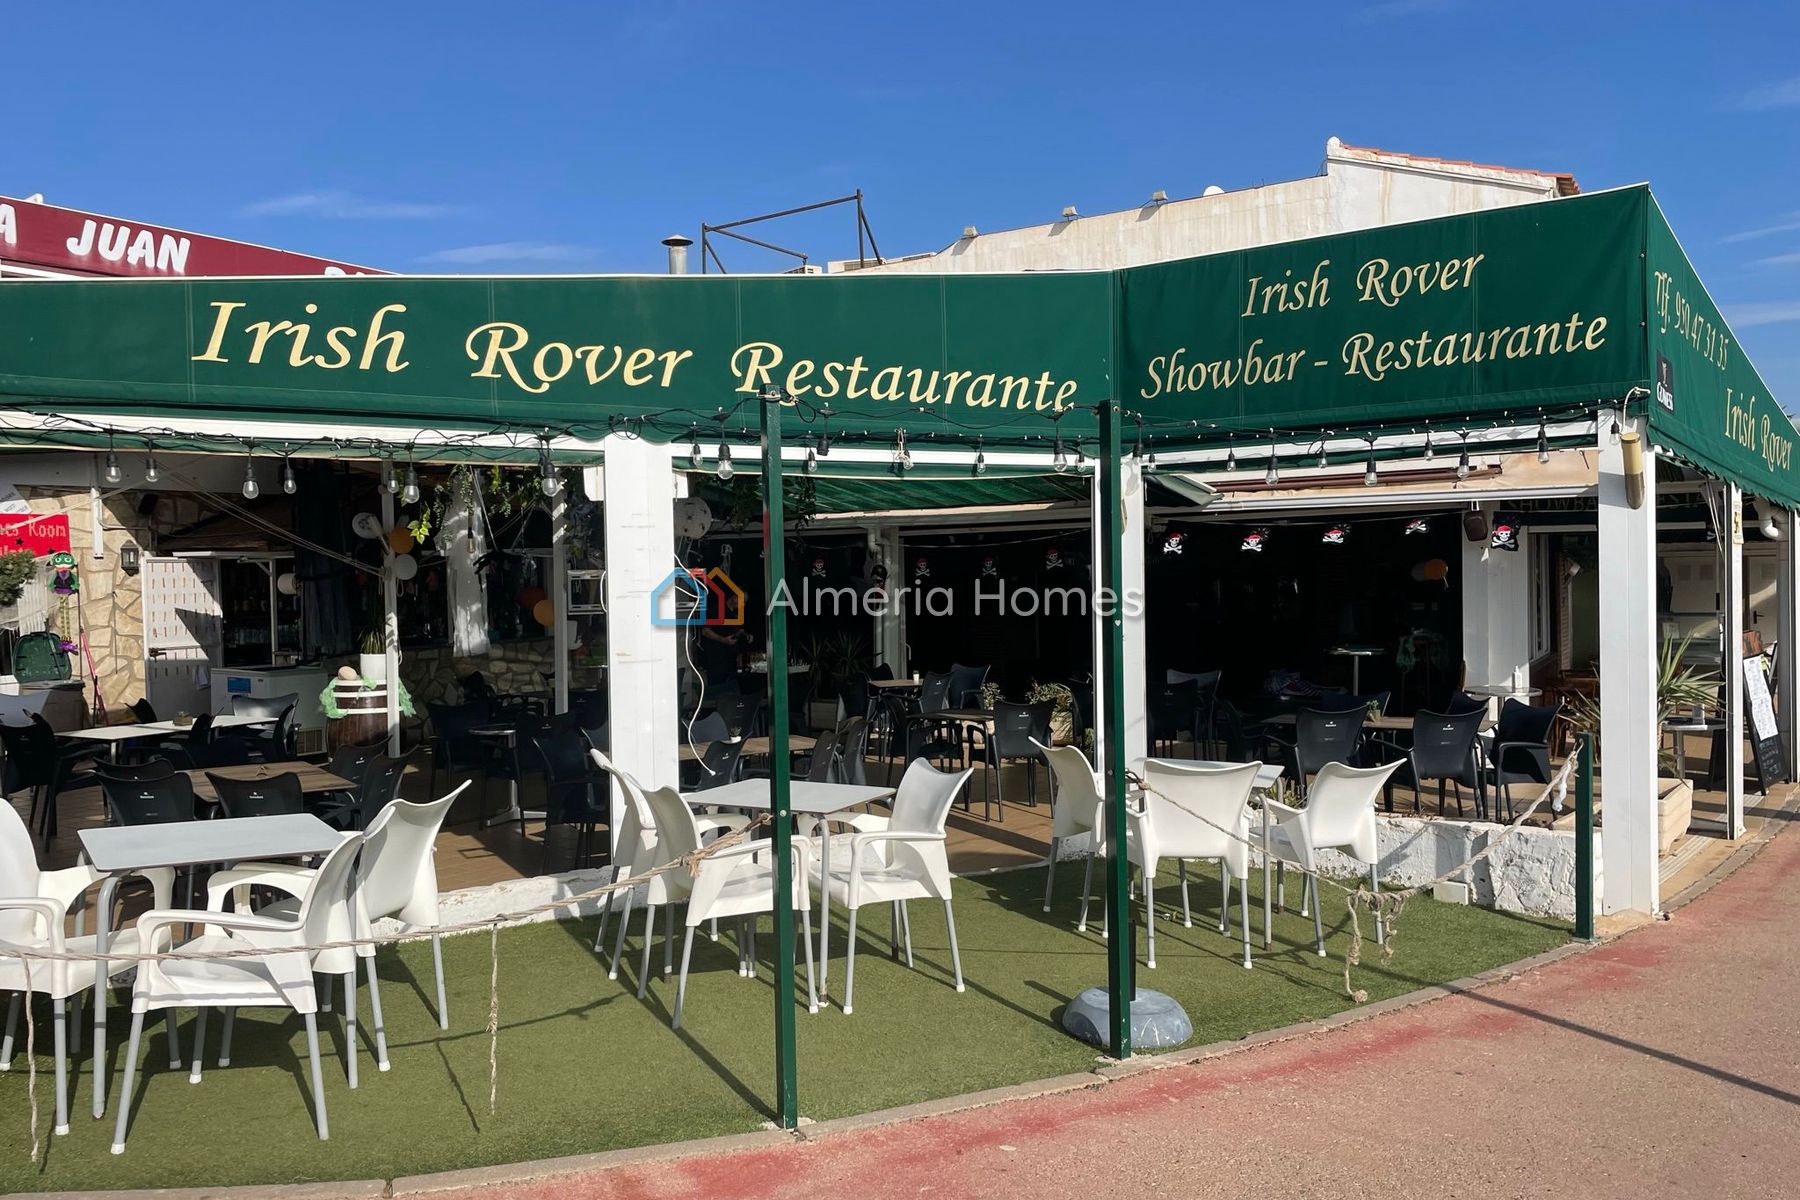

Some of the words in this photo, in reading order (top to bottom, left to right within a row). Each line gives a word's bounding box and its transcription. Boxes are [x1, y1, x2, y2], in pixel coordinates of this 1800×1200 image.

[67, 219, 191, 273] JUAN
[1241, 259, 1331, 318] Irish
[1356, 253, 1485, 307] Rover
[191, 301, 410, 373] Irish
[465, 321, 694, 394] Rover
[730, 341, 1078, 412] Restaurante
[1140, 338, 1306, 399] Showbar
[1342, 312, 1608, 382] Restaurante
[1654, 271, 1673, 334] Tlf.
[1674, 291, 1690, 340] 950
[1691, 312, 1704, 351] 47
[1704, 322, 1717, 363] 31
[1717, 333, 1729, 371] 35
[1724, 387, 1756, 452] Irish
[1760, 413, 1793, 473] Rover
[28, 516, 67, 538] Room
